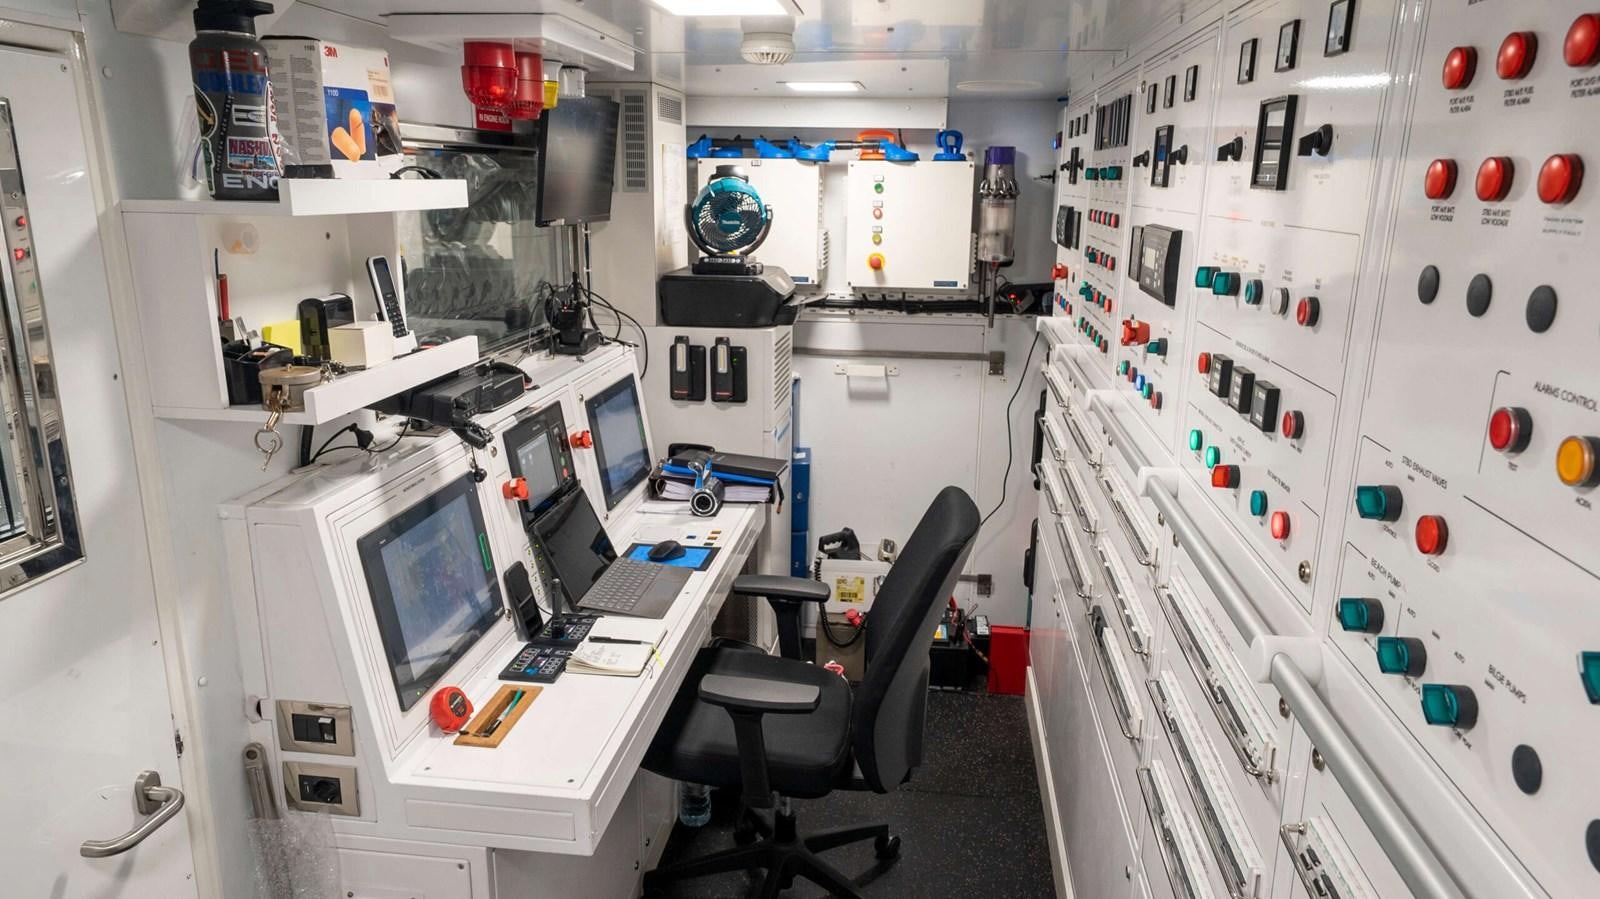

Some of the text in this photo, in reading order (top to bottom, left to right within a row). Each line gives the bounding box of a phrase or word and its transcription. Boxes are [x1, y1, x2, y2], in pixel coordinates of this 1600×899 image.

[324, 46, 338, 58] 3M
[484, 113, 499, 124] ENGINE
[1491, 219, 1509, 227] VOLTAGE
[1534, 381, 1598, 412] ALARMS CONTROL
[1402, 456, 1448, 490] STBD EXHAUST VALVES
[1370, 557, 1402, 588] BEACH PUMP
[1487, 664, 1528, 704] BILGE PUMPS
